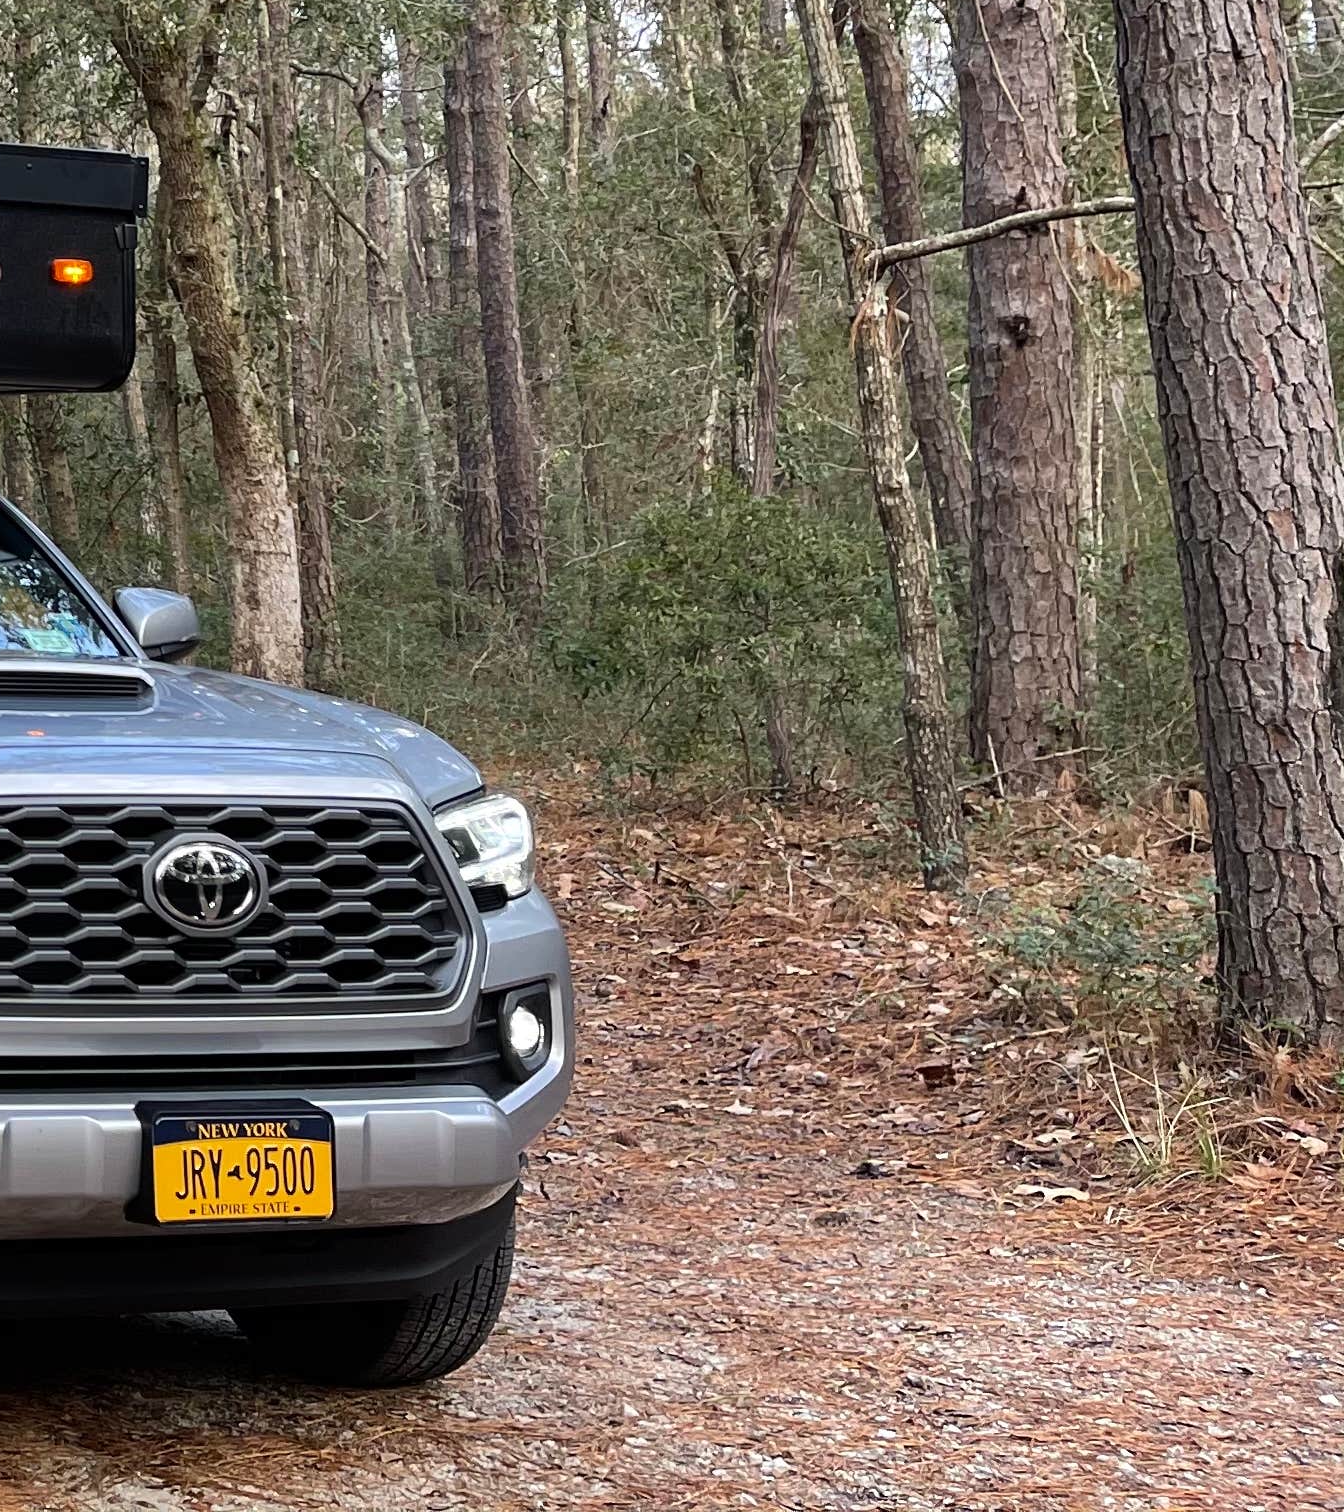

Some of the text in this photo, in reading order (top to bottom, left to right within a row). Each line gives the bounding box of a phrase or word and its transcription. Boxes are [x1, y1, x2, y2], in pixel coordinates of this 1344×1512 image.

[198, 1122, 288, 1139] NEW YORK
[201, 1201, 291, 1216] EMPIRE STATE
